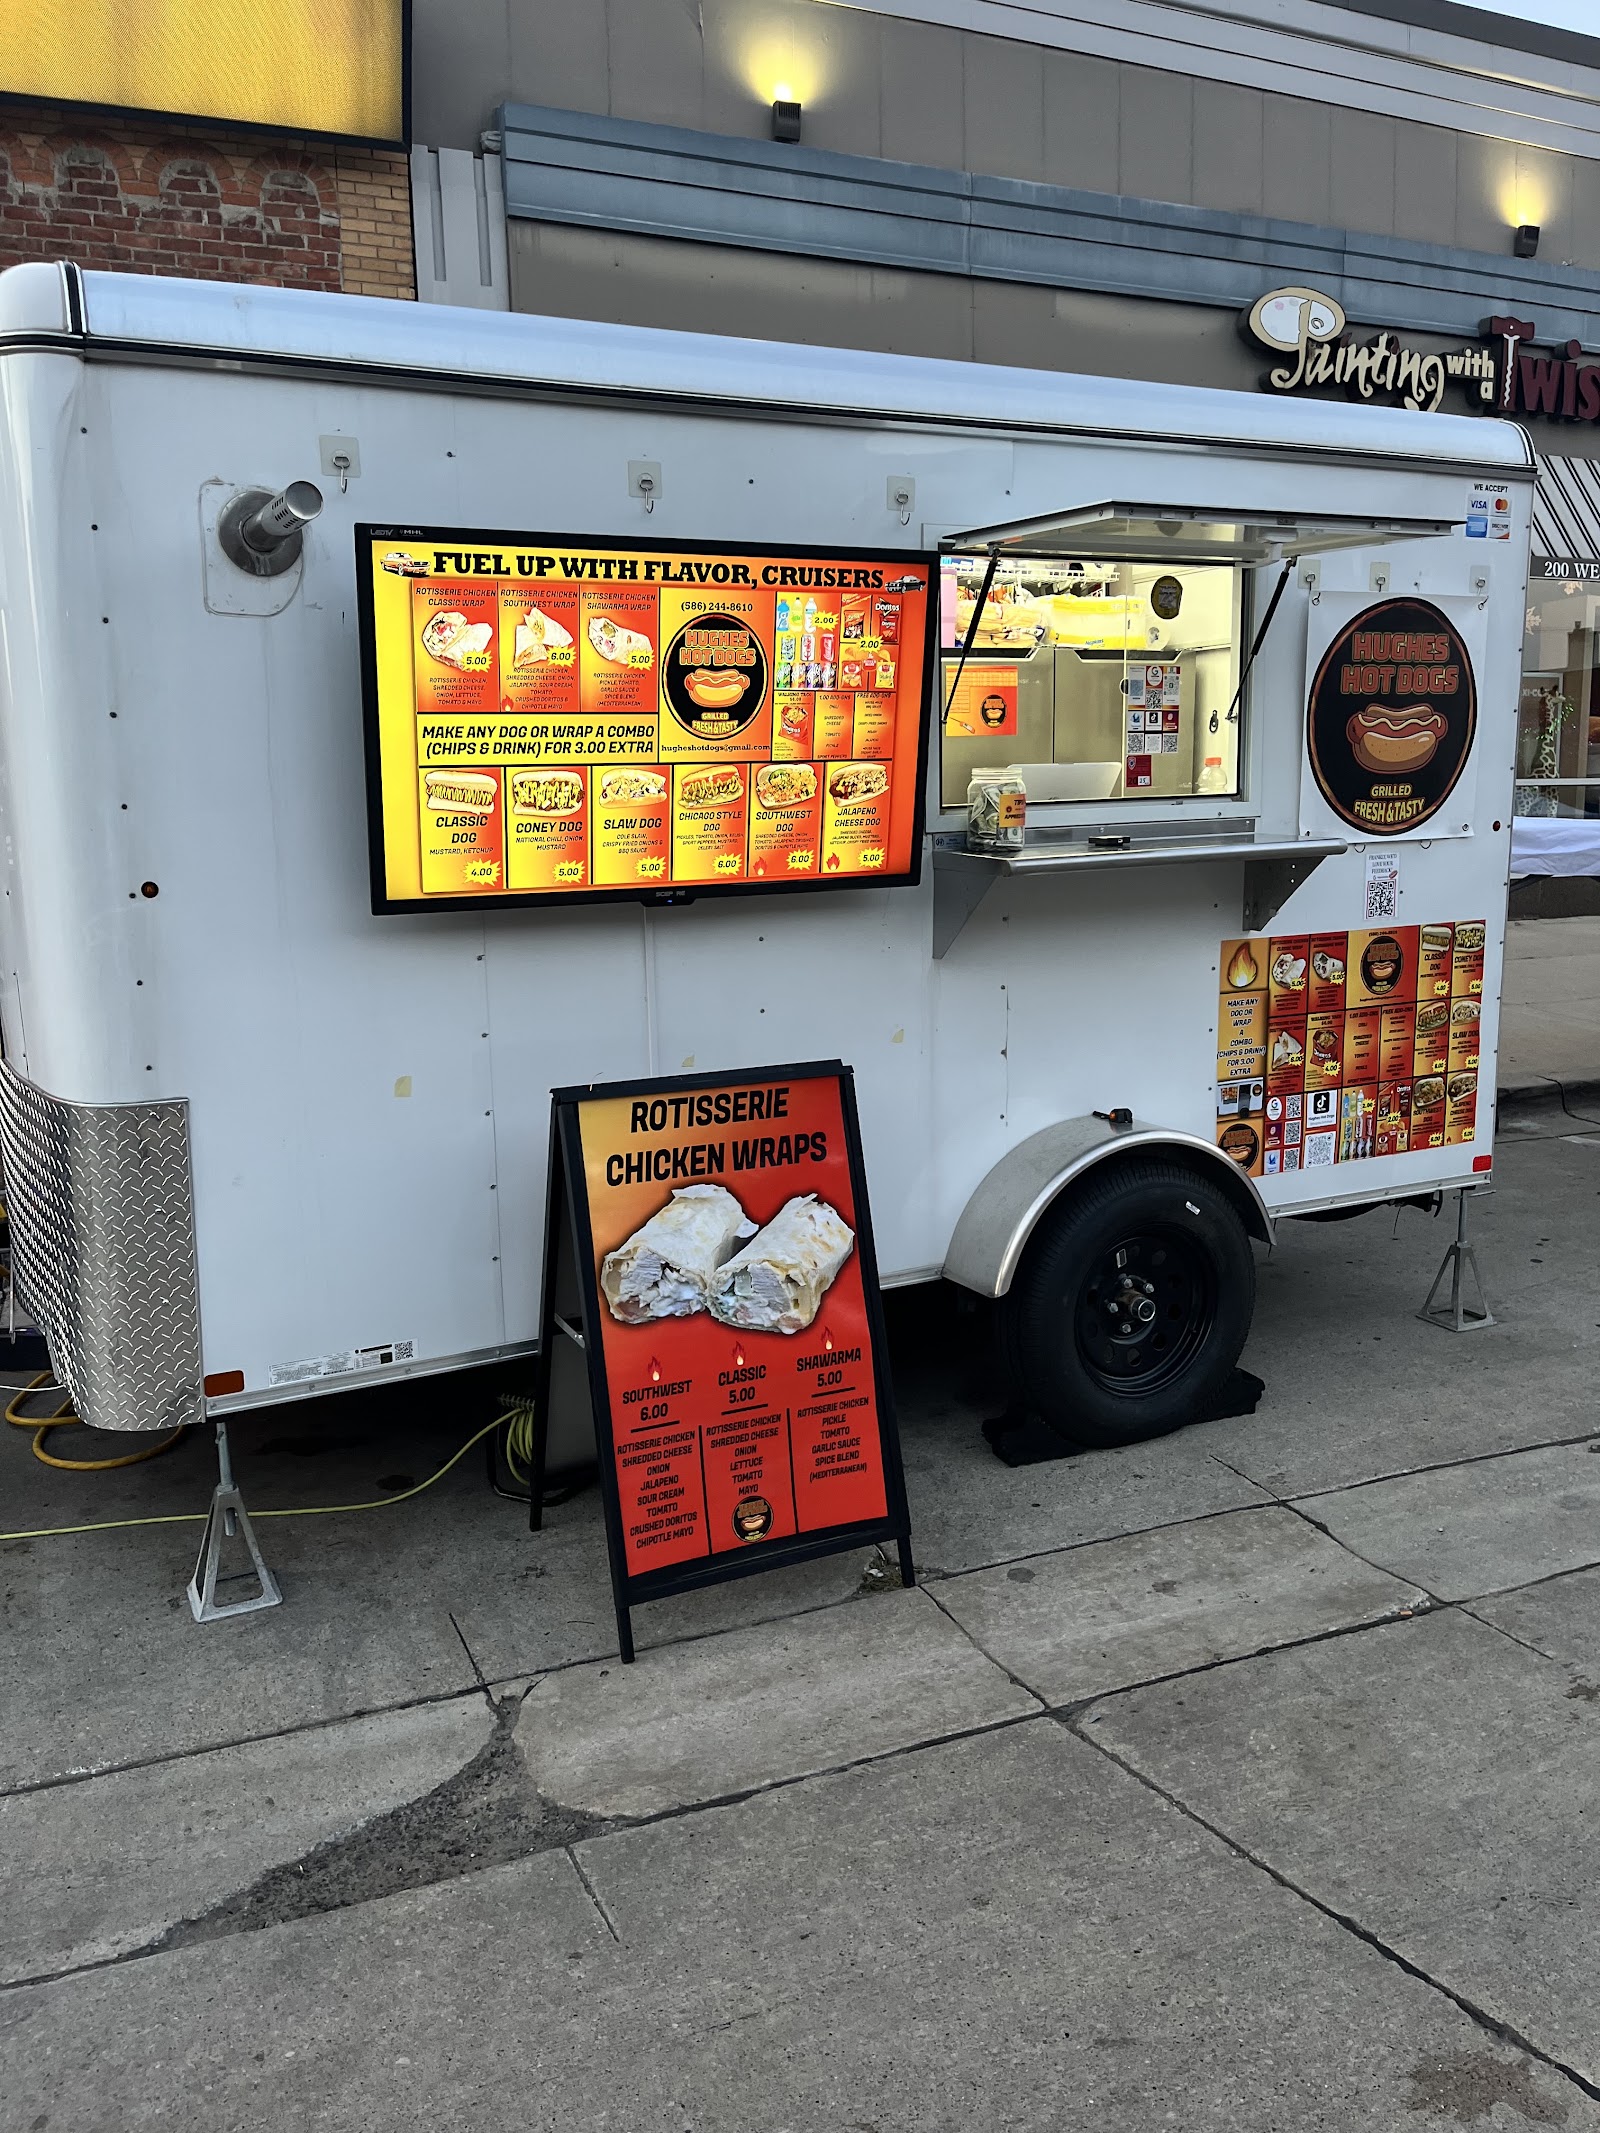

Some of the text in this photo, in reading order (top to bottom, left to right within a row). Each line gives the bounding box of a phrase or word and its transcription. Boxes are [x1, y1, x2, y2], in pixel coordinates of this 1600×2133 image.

[1249, 286, 1445, 413] Painting
[1446, 346, 1494, 378] with
[1480, 380, 1493, 402] a
[1484, 484, 1508, 493] ACCEPT
[1471, 500, 1487, 509] VISA
[433, 552, 884, 590] FUEL UP WITH FLAVOR, CRUISERS
[1544, 561, 1570, 578] 200
[416, 587, 496, 597] ROTISSERIE CHICKEN
[500, 589, 578, 598] ROTISSERIE CHICKEN
[582, 592, 656, 601] ROTISSERIE CHICKEN
[462, 599, 485, 607] WRAP
[503, 600, 576, 609] SOUTHWEST WRAP
[587, 602, 651, 611] SHAWARMA WRAP
[681, 601, 753, 612] (586) 244-8610
[685, 629, 749, 647] HUGHES
[860, 641, 880, 649] 2.00
[1352, 632, 1449, 662] HUGHES
[466, 656, 487, 665] 5.00
[551, 652, 571, 660] 6.00
[631, 655, 650, 664] 5.00
[680, 647, 756, 666] HOT DOGS
[1340, 664, 1459, 695] HOT DOGS
[701, 712, 729, 720] GRILLED
[422, 726, 655, 738] MAKE ANY DOG OR WRAP A COMBO
[692, 720, 714, 734] FRESH
[426, 741, 654, 760] (CHIPS & DRINK) FOR 3.00 EXTRA
[1371, 784, 1412, 798] GRILLED
[679, 811, 743, 820] CHICAGO STYLE
[756, 810, 812, 820] SOUTHWEST
[838, 808, 876, 816] JALAPENO
[1354, 801, 1386, 822] FRESH
[436, 815, 488, 828] CLASSIC
[516, 822, 583, 833] CONEY DOG
[604, 818, 662, 830] SLAW DOG
[704, 824, 720, 832] DOG
[776, 824, 794, 832] DOG
[834, 818, 880, 827] CHEESE DOG
[452, 833, 477, 844] DOG
[718, 860, 737, 868] 6.00
[791, 854, 810, 863] 6.00
[471, 868, 492, 876] 4.00
[558, 868, 579, 876] 5.00
[641, 864, 661, 872] 5.00
[1230, 1038, 1252, 1046] COMBO
[630, 1088, 790, 1133] ROTISSERIE
[606, 1132, 827, 1186] CHICKEN WRAPS
[796, 1348, 862, 1372] SHAWARMA
[718, 1365, 766, 1386] CLASSIC
[818, 1370, 842, 1388] 5.00
[622, 1380, 692, 1404] SOUTHWEST
[729, 1386, 755, 1404] 5.00
[640, 1402, 668, 1420] 6.00
[798, 1396, 868, 1418] ROTISSERIE CHICKEN
[706, 1414, 782, 1436] ROTISSERIE CHICKEN
[822, 1414, 846, 1426] PICKLE
[710, 1427, 778, 1448] SHREDDED CHEESE
[820, 1426, 850, 1440] TOMATO
[618, 1430, 695, 1455] ROTISSERIE CHICKEN
[812, 1437, 860, 1454] GARLIC SAUCE
[622, 1444, 692, 1468] SHREDDED CHEESE
[734, 1445, 756, 1457] ONION
[730, 1456, 764, 1471] LETTUCE
[815, 1450, 859, 1466] SPICE BLEND
[647, 1463, 670, 1476] ONION
[810, 1462, 867, 1482] (MEDITERRANEAN)
[640, 1474, 678, 1491] JALAPENO
[732, 1470, 762, 1484] TOMATO
[637, 1487, 684, 1506] SOUR CREAM
[738, 1484, 758, 1496] MAYO
[646, 1502, 678, 1518] TOMATO
[630, 1512, 698, 1536] CRUSHED DORITOS
[636, 1526, 694, 1548] CHIPOTLE MAYO
